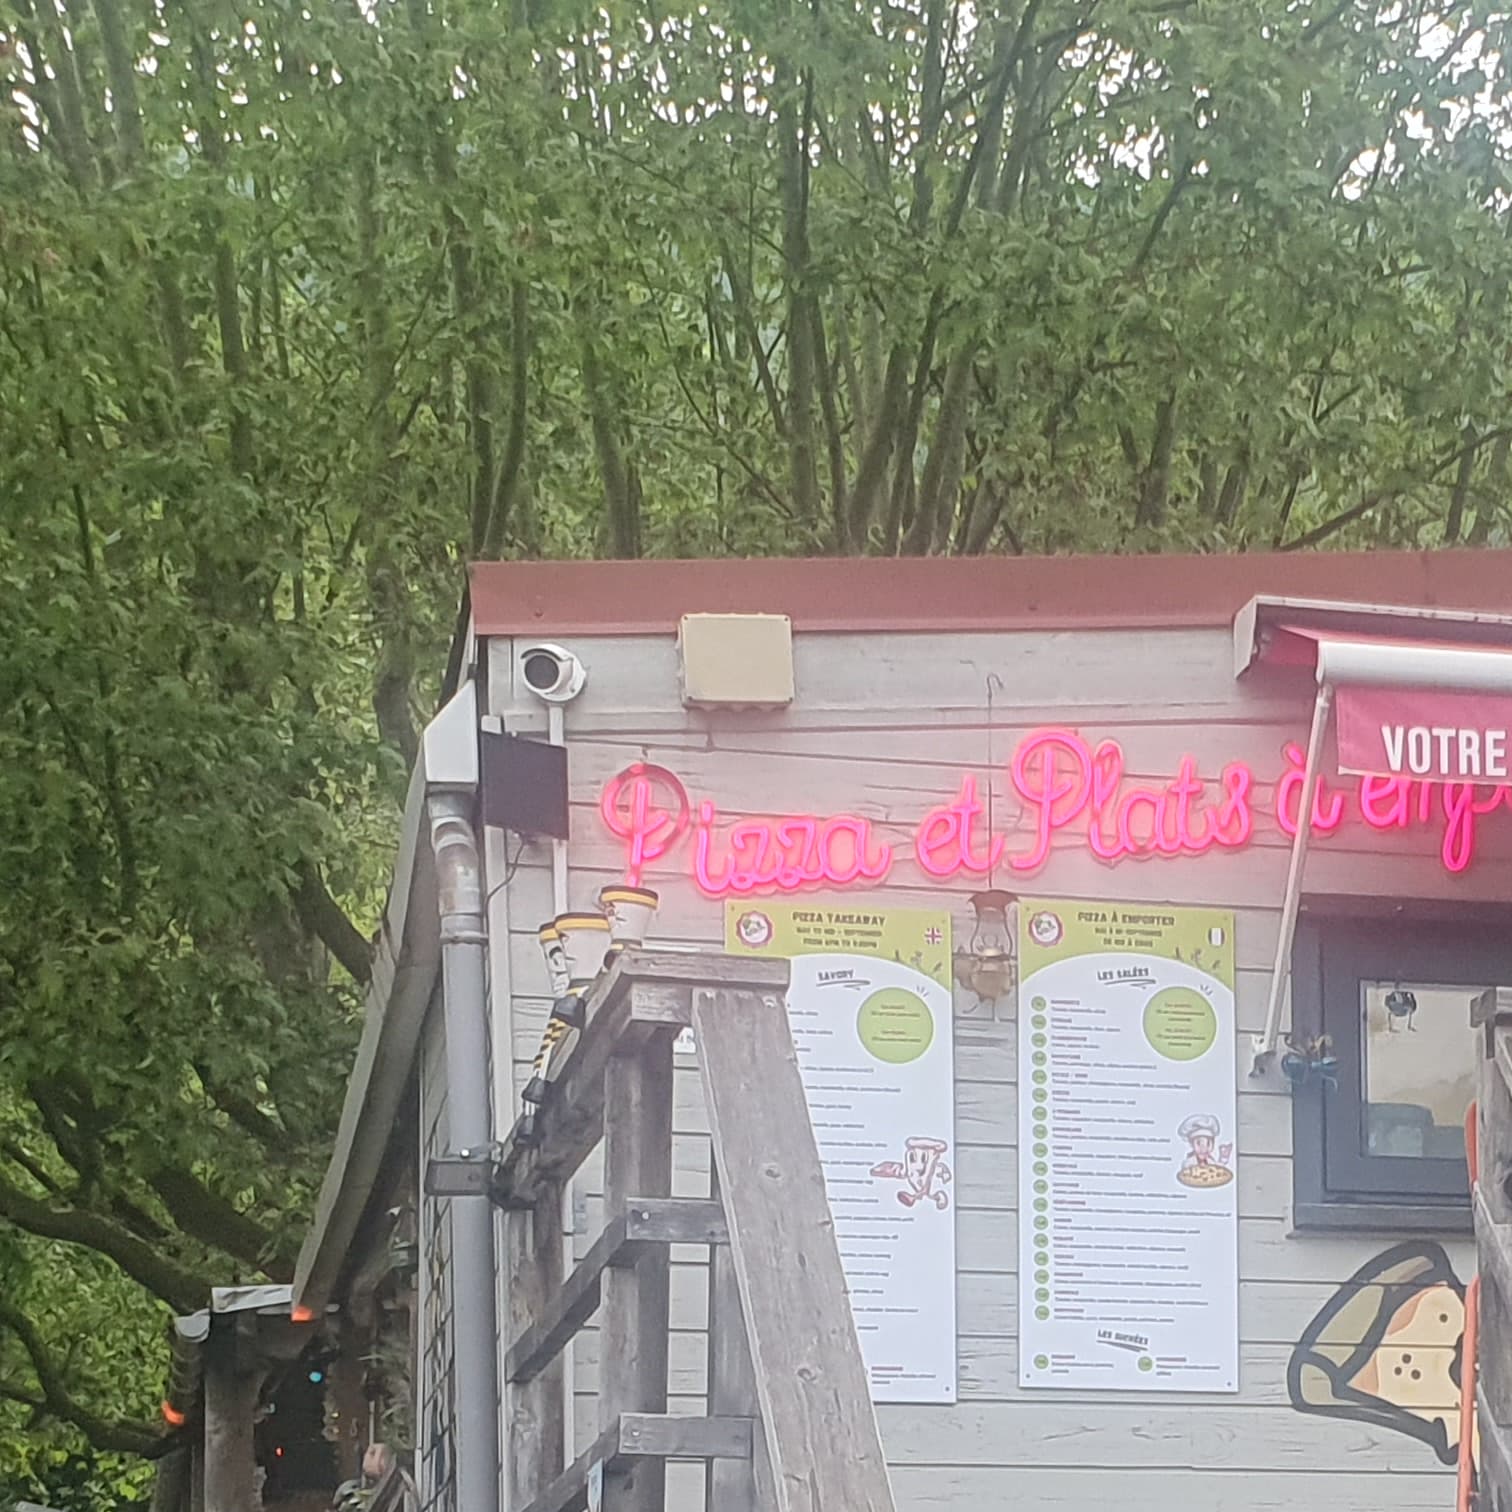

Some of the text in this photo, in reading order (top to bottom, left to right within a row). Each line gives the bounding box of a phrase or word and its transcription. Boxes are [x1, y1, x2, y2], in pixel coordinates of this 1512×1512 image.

[1381, 725, 1508, 778] VOTRE
[602, 762, 894, 897] Pizza
[914, 774, 1005, 880] et
[1009, 727, 1254, 873] Plats
[1275, 742, 1346, 838] à
[792, 911, 885, 926] PIZZA TAKEAWAY
[1078, 911, 1107, 923] PIZZA
[1097, 970, 1114, 981] LES
[1098, 1329, 1113, 1340] LES
